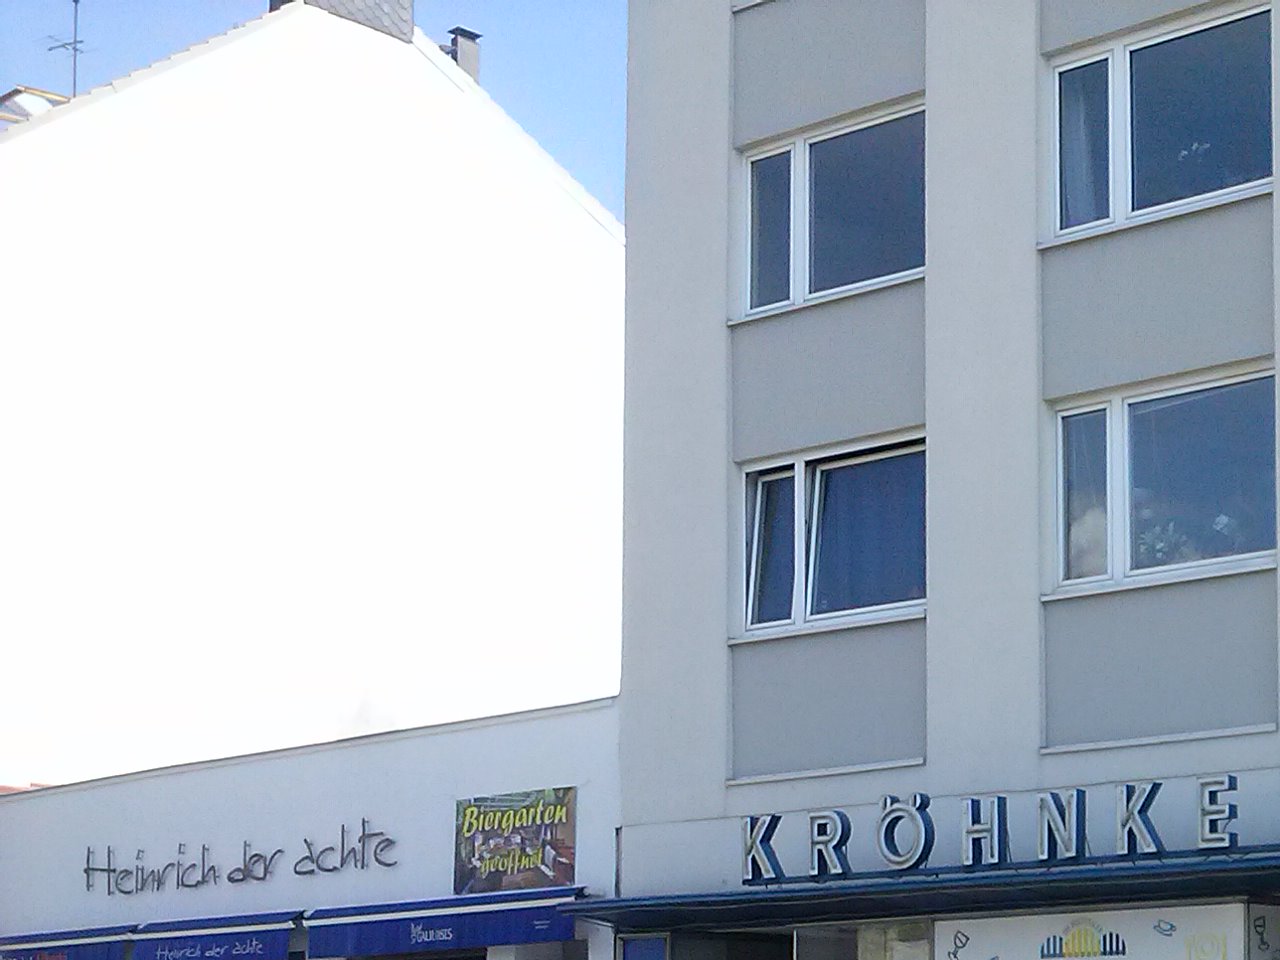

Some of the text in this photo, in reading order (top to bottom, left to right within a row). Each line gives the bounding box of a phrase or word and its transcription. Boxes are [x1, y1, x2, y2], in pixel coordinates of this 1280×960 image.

[462, 799, 568, 838] Biergarten
[743, 774, 1237, 882] KRÖHNKE
[84, 843, 219, 896] Heinrich
[227, 840, 284, 883] der
[156, 944, 201, 960] Heinrich
[204, 943, 229, 958] der
